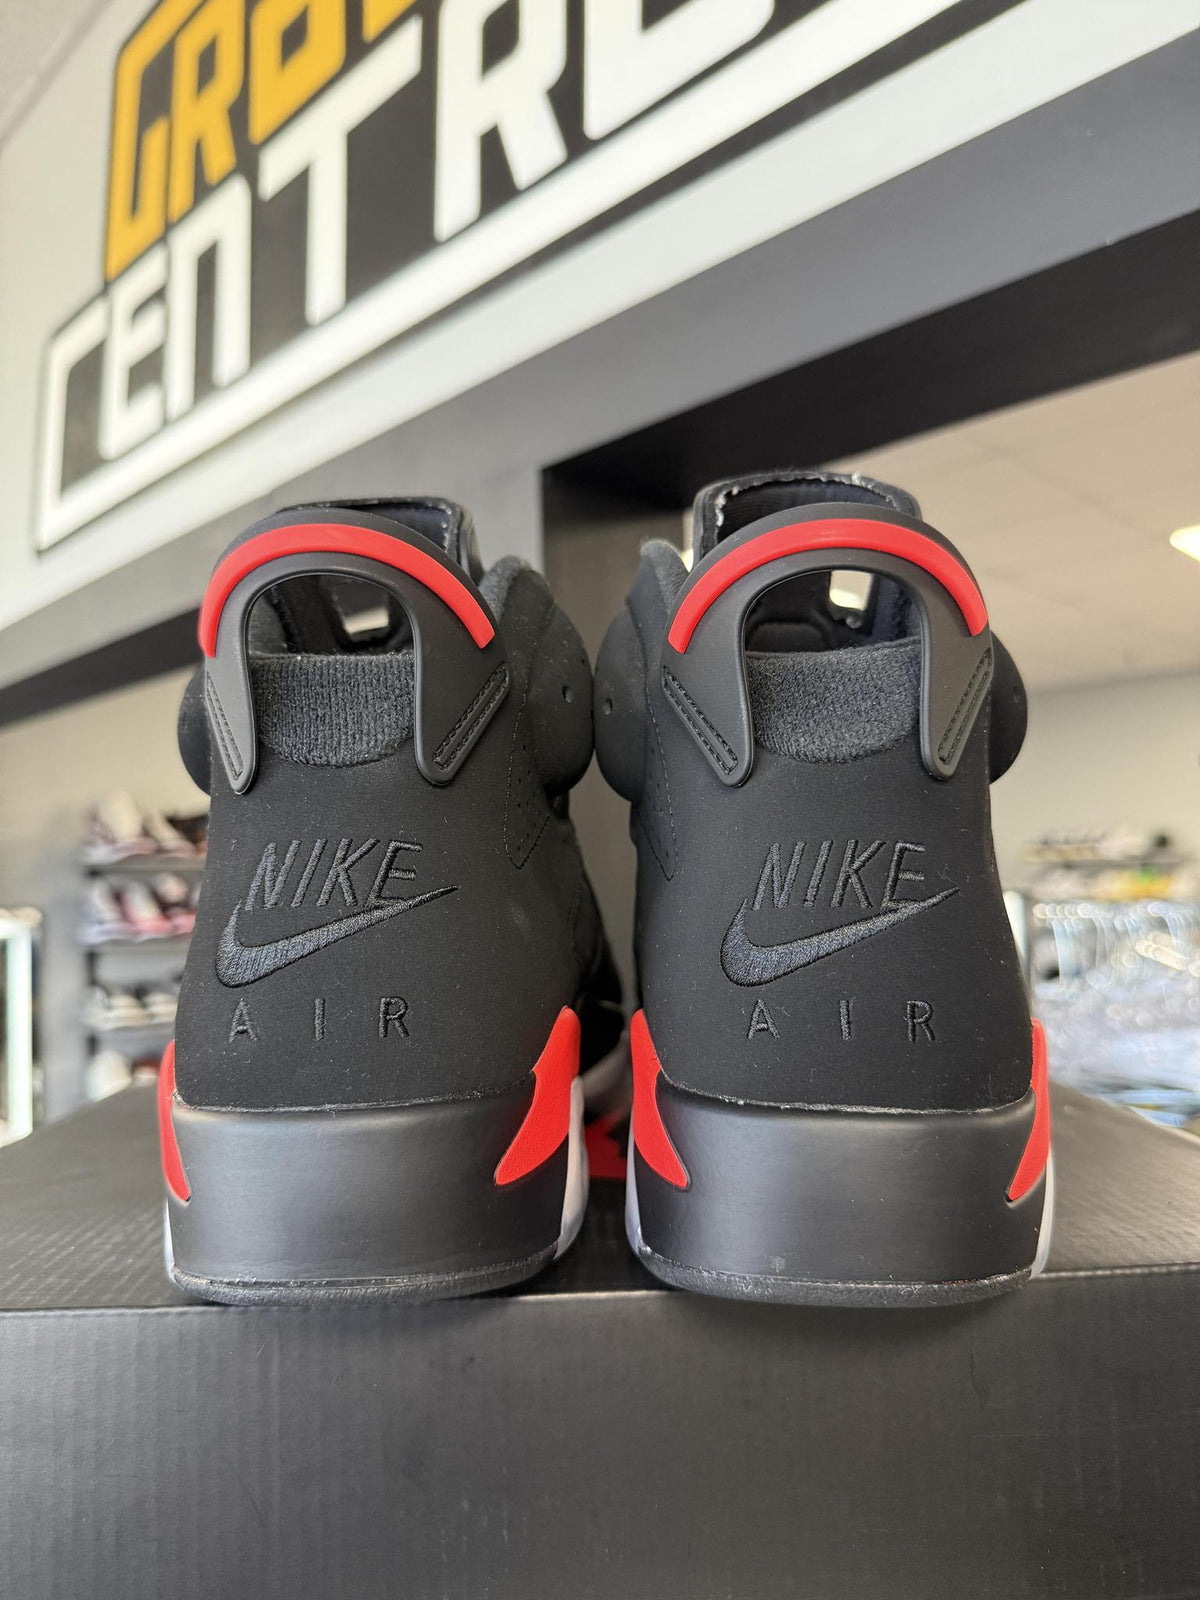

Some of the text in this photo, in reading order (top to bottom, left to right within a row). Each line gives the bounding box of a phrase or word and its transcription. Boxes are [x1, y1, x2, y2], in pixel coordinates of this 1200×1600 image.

[245, 838, 423, 911] NIKE
[751, 839, 926, 911] NIKE
[229, 996, 410, 1042] AIR
[747, 999, 936, 1042] AIR
